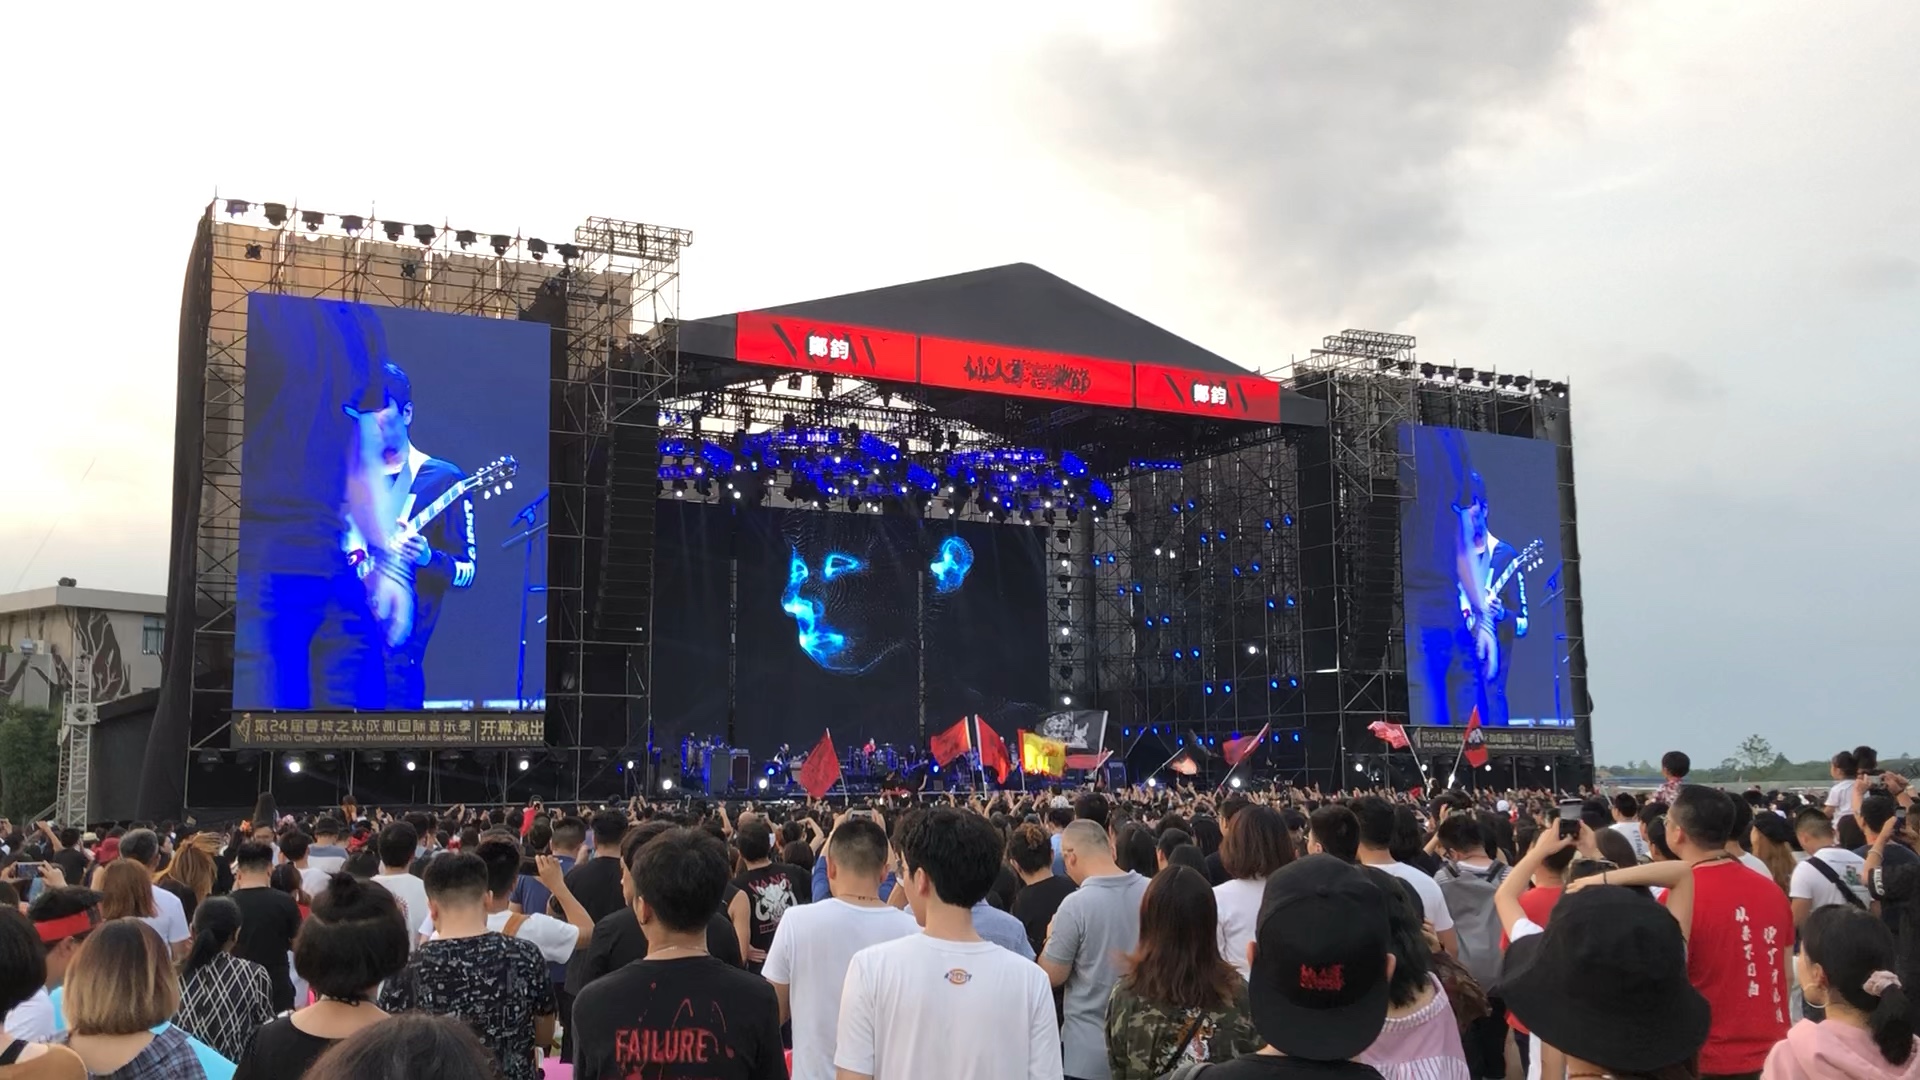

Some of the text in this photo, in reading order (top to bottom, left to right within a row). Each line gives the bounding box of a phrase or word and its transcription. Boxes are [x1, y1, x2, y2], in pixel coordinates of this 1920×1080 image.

[481, 719, 545, 736] 开幕演出
[614, 1028, 709, 1063] FAILURE
